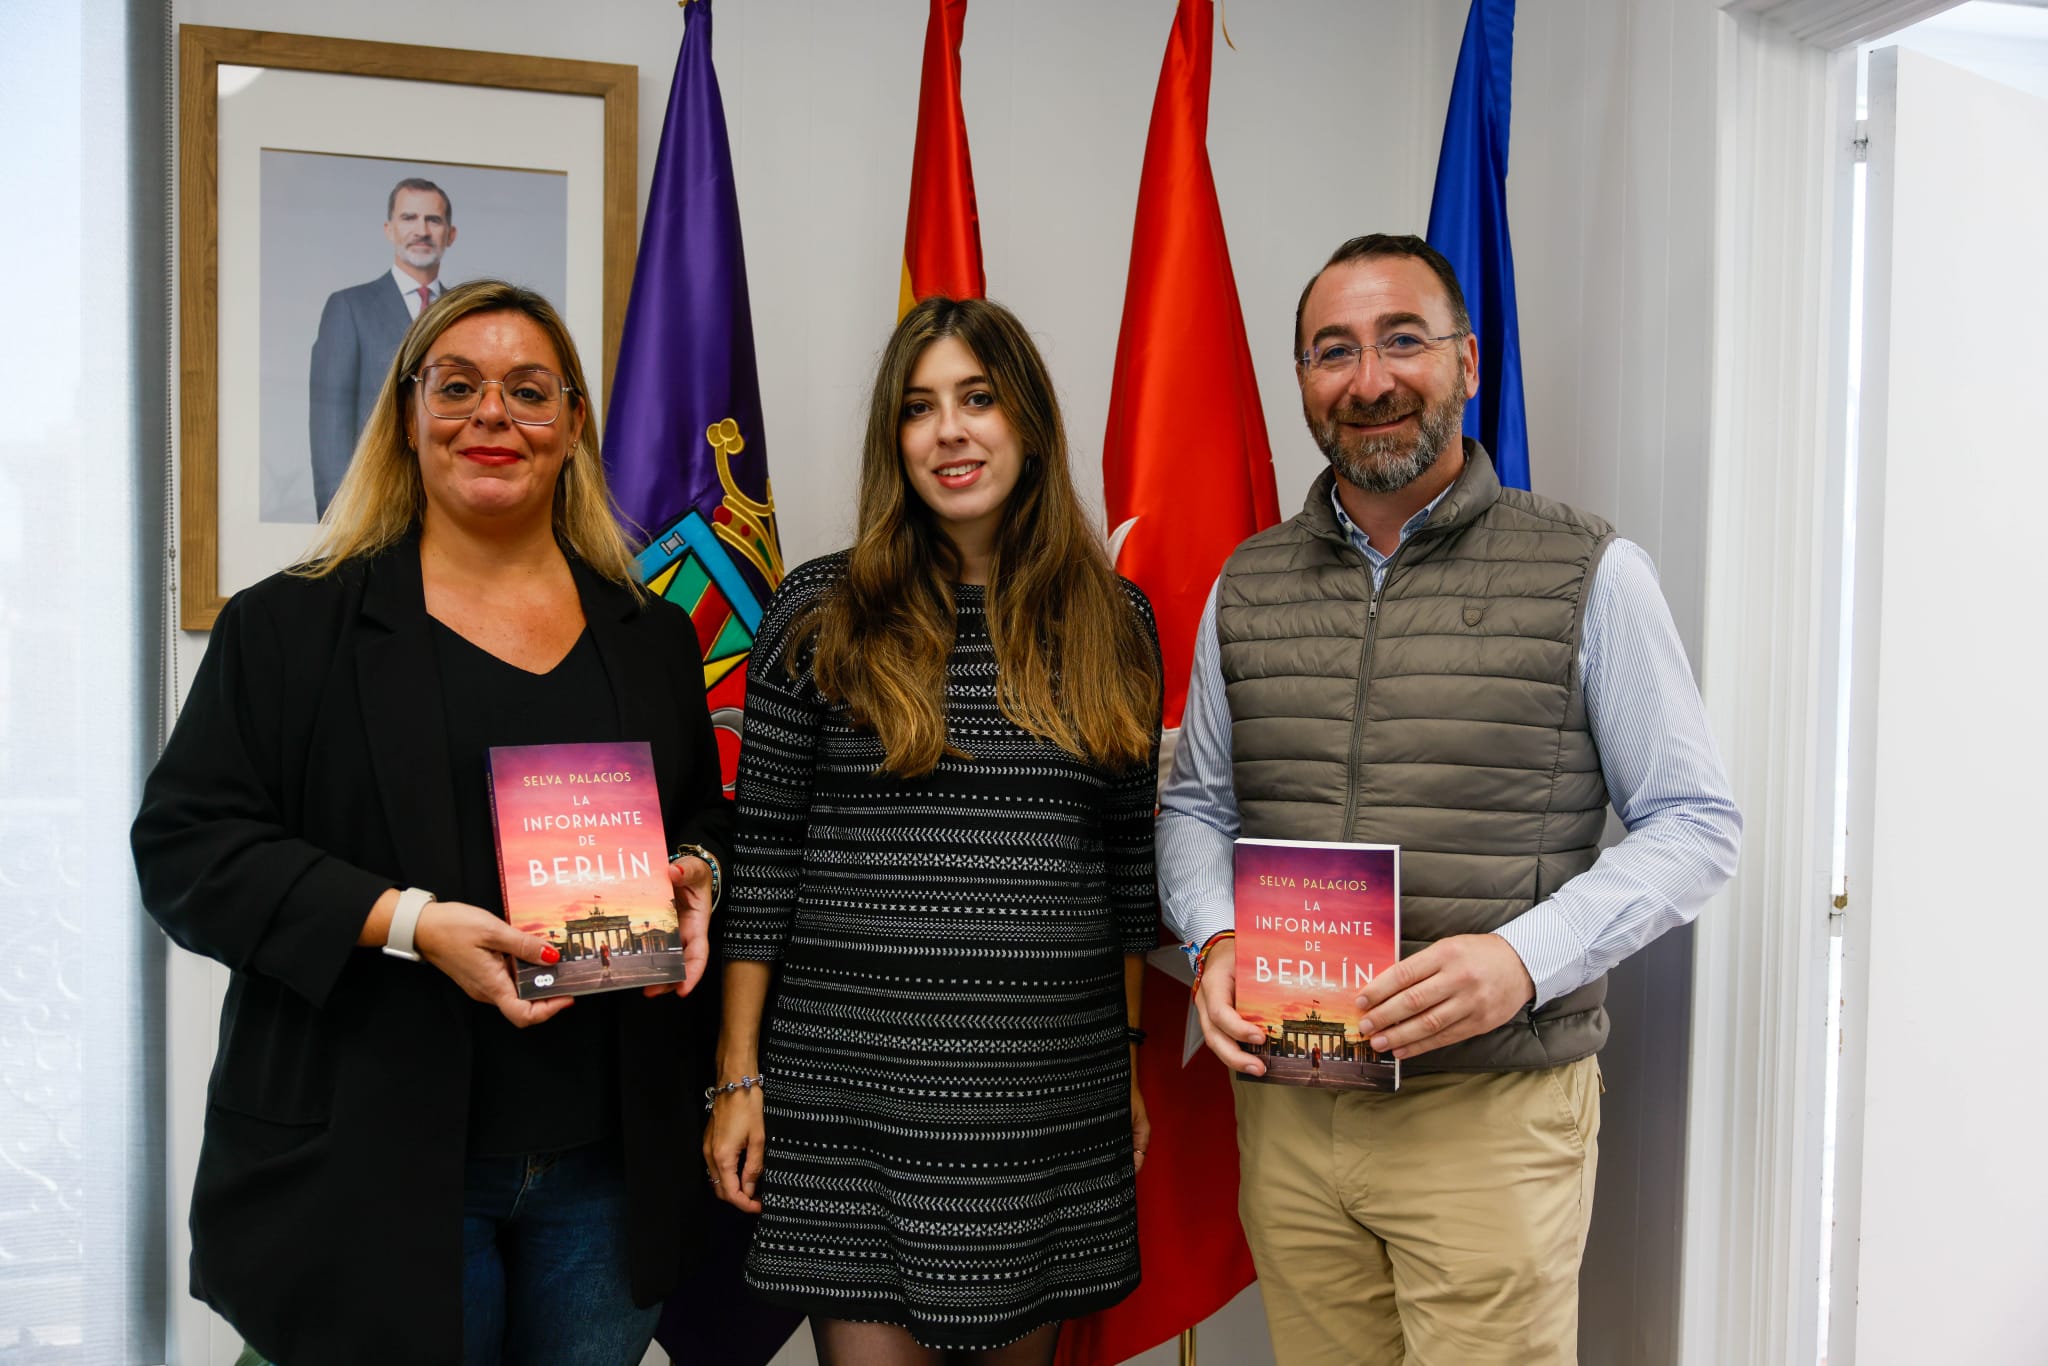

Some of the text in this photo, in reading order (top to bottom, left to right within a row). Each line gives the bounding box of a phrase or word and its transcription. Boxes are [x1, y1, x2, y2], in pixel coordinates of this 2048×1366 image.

[523, 772, 632, 787] SELVA PALACIOS
[573, 795, 591, 807] LA
[523, 811, 643, 832] INFORMANTE
[578, 835, 597, 847] DE
[528, 848, 651, 887] BERLÍN
[1259, 875, 1368, 891] SELVA PALACIOS
[1304, 900, 1321, 912] LA
[1255, 915, 1373, 937] INFORMANTE
[1304, 940, 1322, 952] DE
[1255, 956, 1374, 989] BERLÍN
